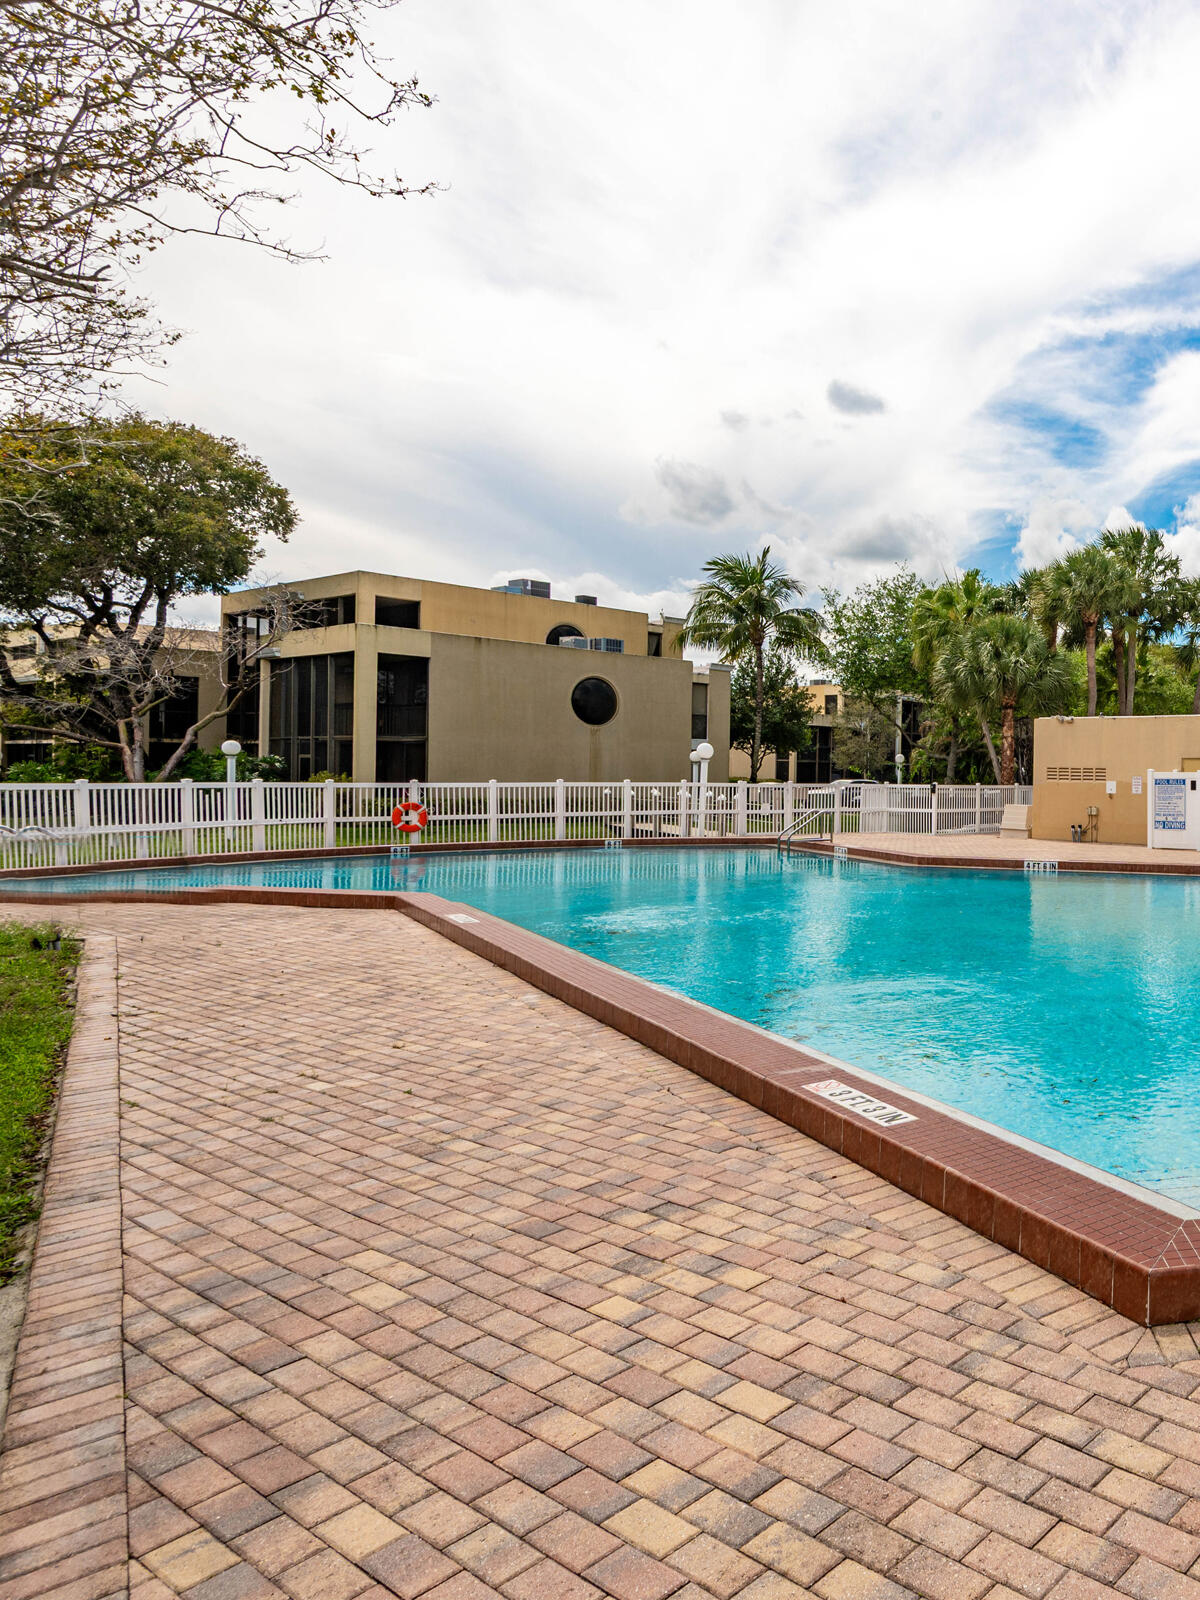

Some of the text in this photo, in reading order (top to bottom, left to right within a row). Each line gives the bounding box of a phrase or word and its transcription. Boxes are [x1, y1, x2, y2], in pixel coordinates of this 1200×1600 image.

[828, 1089, 909, 1124] 3 FT 3 IN
